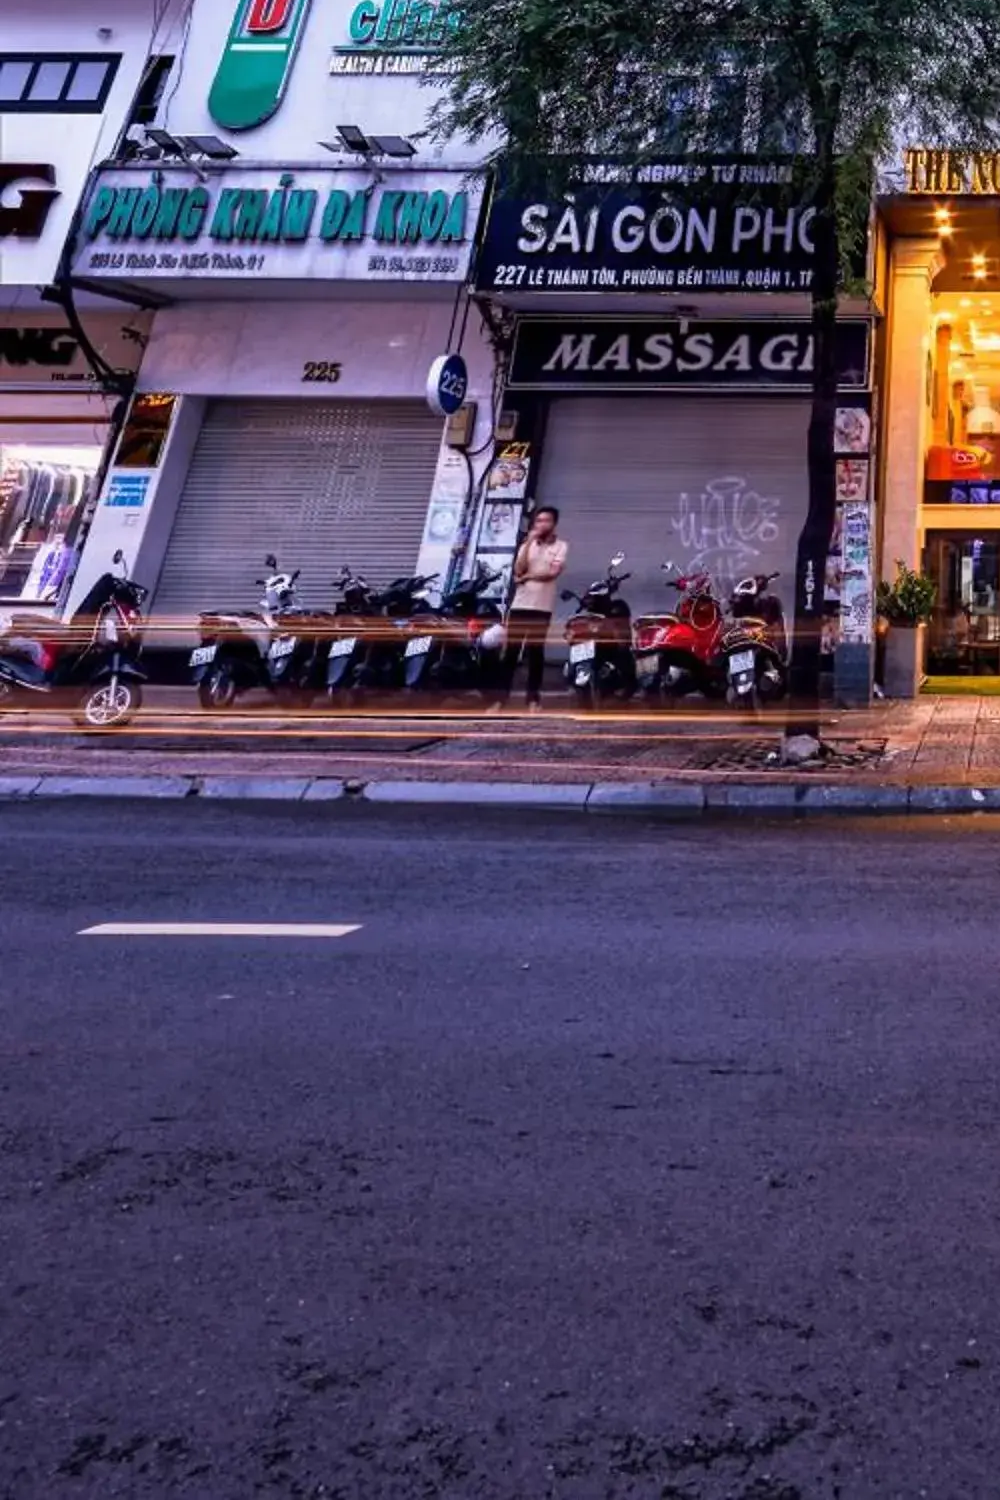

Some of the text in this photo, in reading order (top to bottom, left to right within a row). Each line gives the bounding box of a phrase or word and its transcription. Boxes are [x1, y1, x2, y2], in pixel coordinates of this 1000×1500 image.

[905, 150, 962, 193] THE
[493, 265, 527, 285] 227
[301, 361, 342, 382] 225
[440, 370, 465, 399] 225
